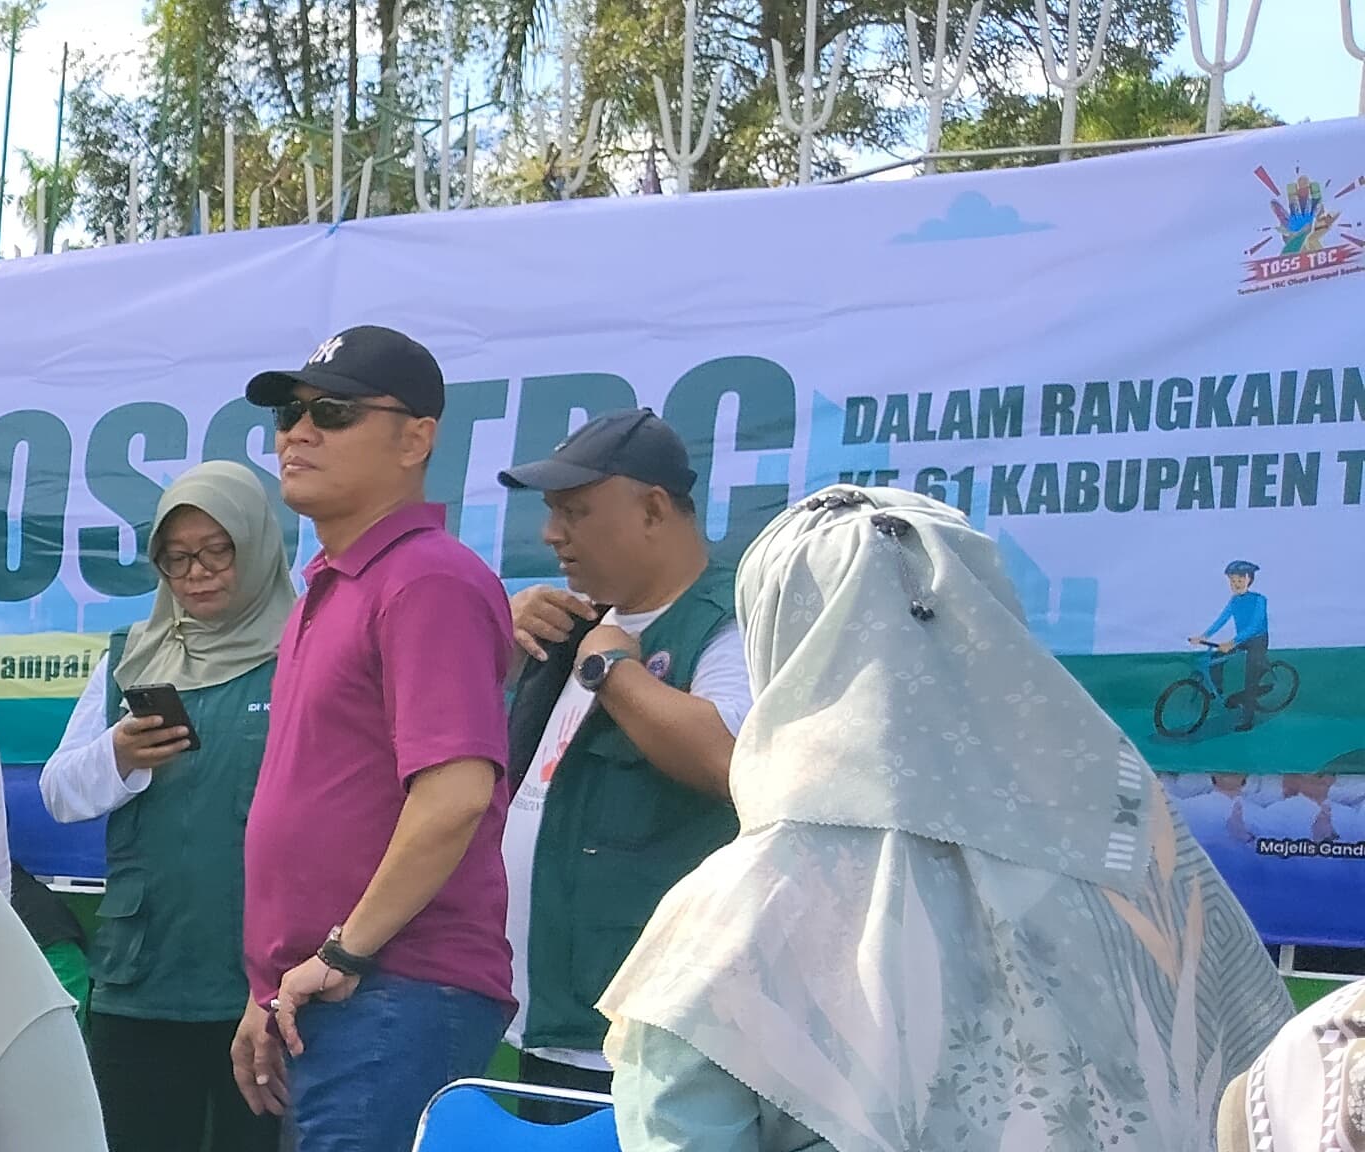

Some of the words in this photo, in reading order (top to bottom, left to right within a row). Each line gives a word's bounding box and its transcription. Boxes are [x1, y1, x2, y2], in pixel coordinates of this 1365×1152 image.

[1260, 256, 1301, 277] TOSS
[1307, 249, 1338, 268] TBC
[840, 385, 1026, 444] DALAM
[1040, 367, 1365, 437] RANGKAIAN
[914, 466, 975, 516] 61
[988, 451, 1320, 517] KABUPATEN
[1260, 841, 1316, 856] Majelis
